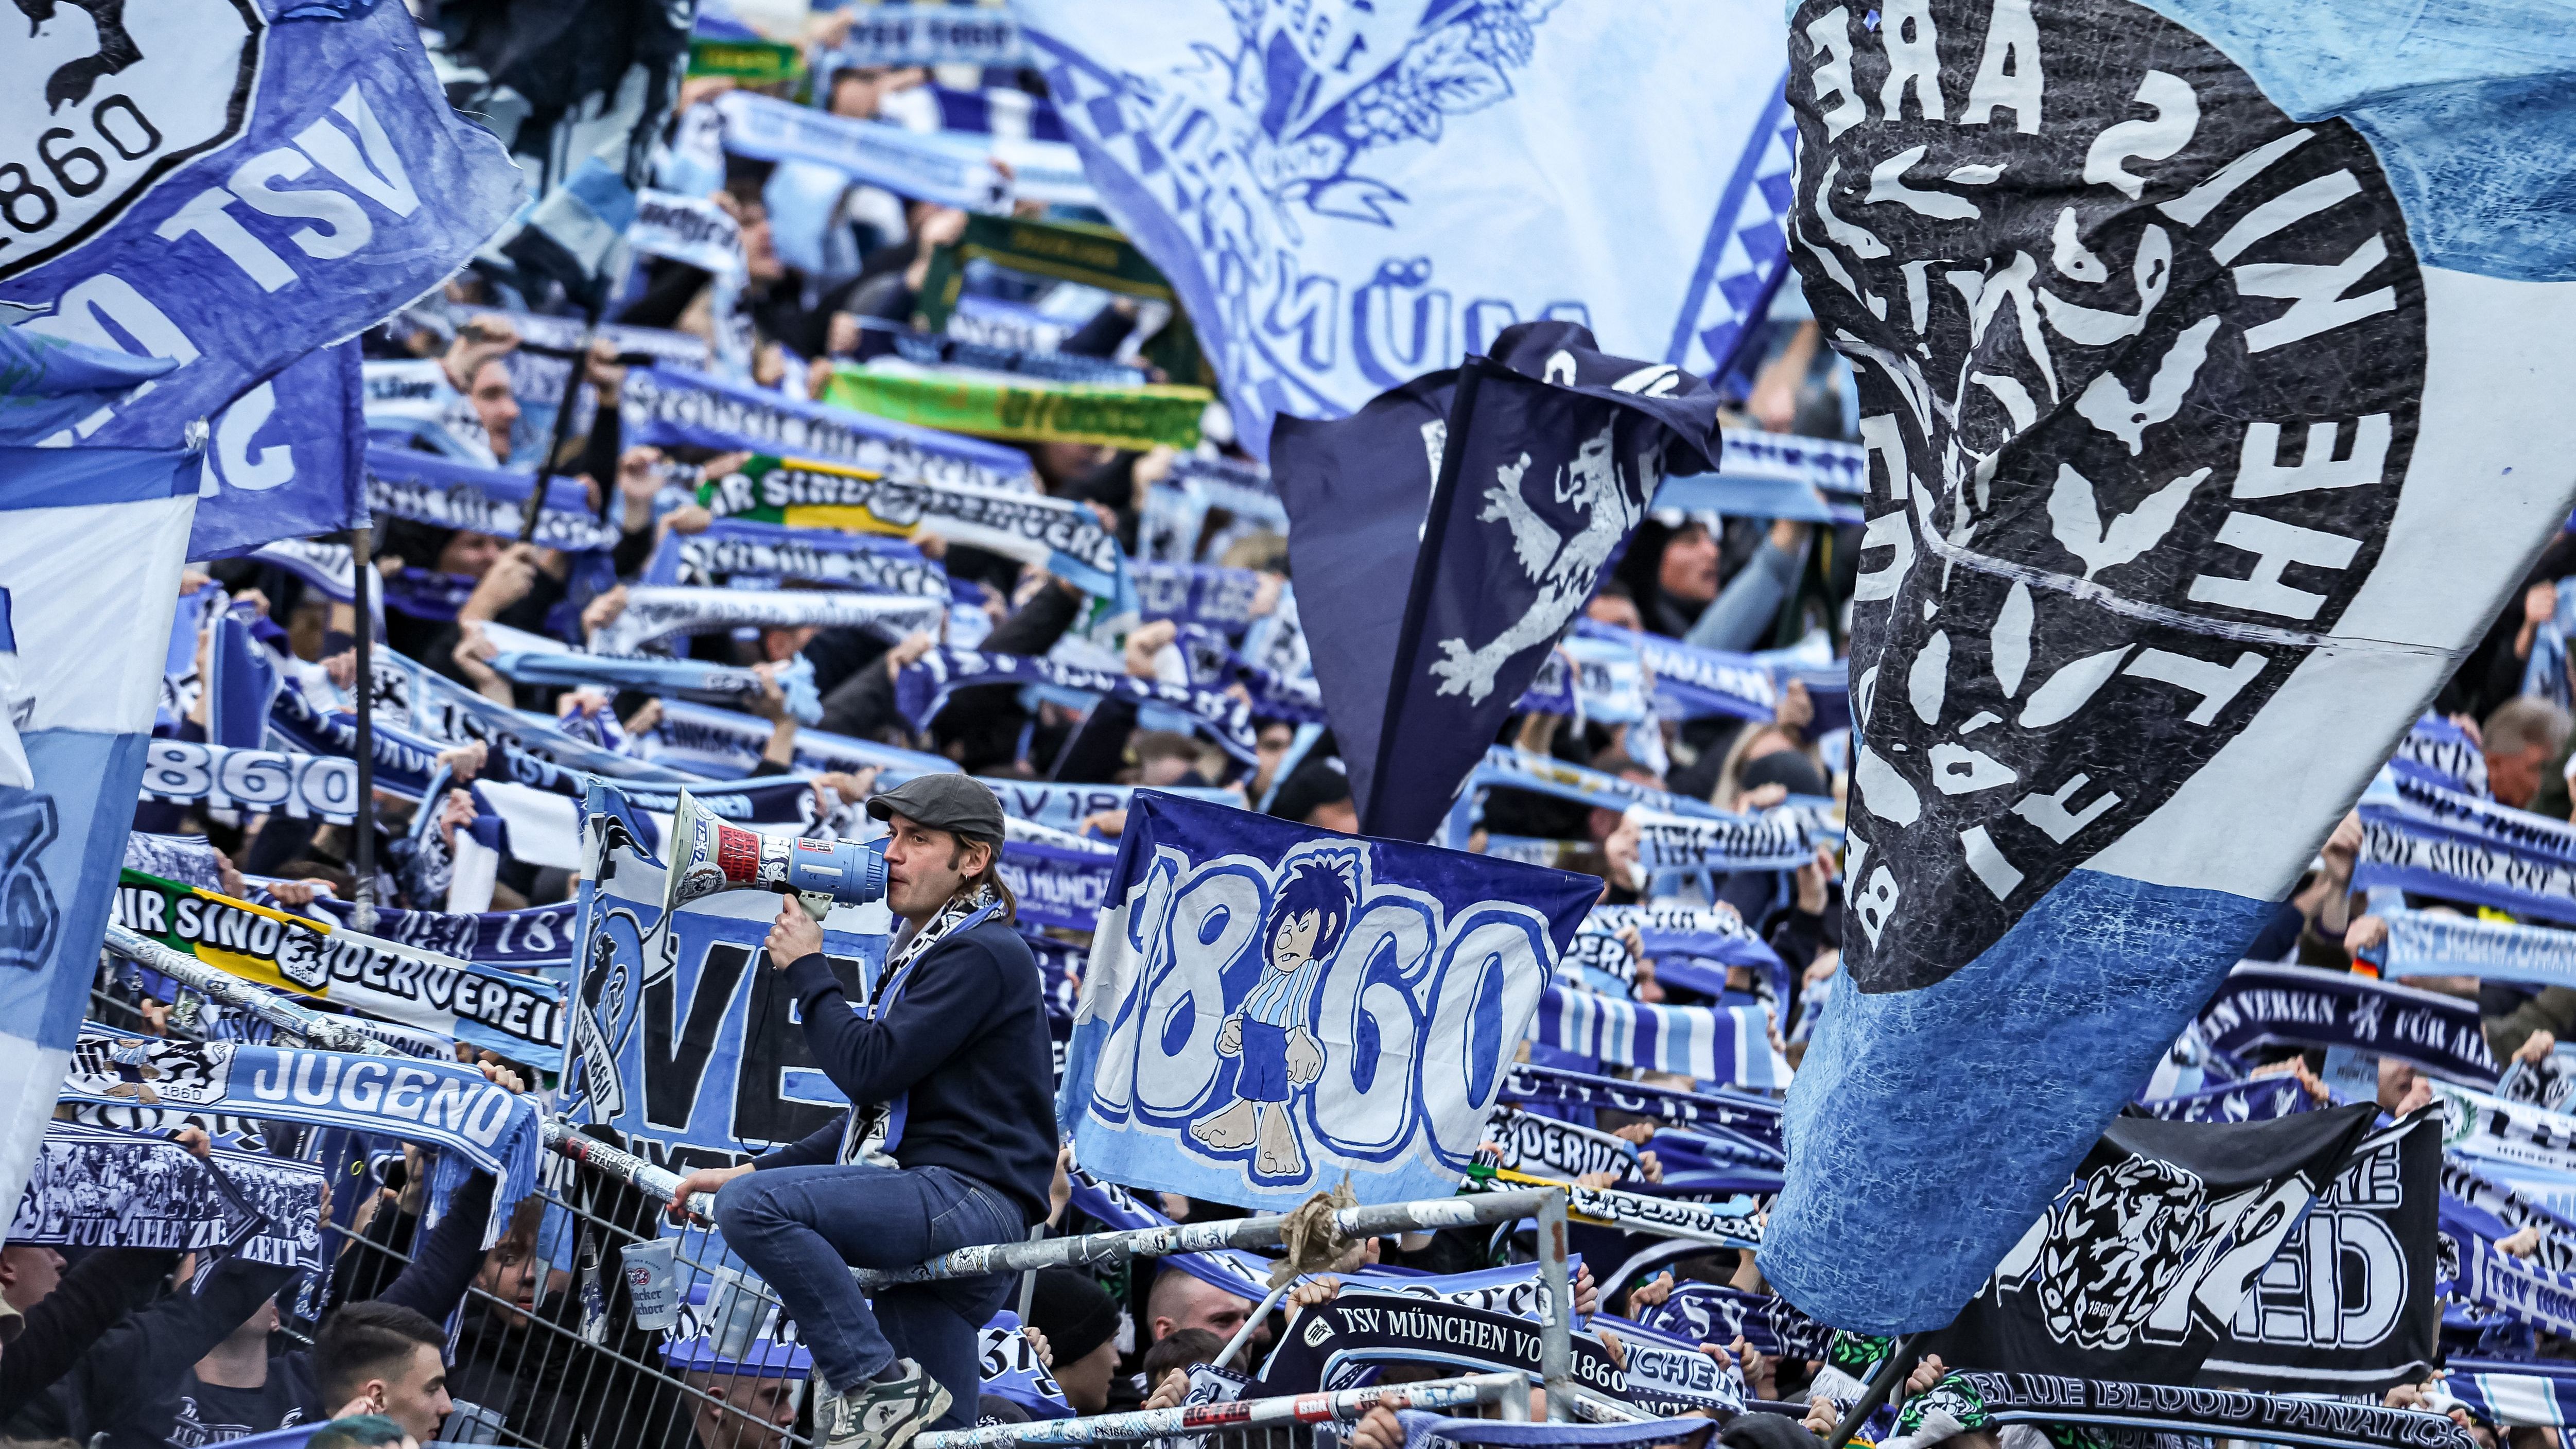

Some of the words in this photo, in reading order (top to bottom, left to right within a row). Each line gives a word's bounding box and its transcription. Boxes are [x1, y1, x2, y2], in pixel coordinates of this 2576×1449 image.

[0, 94, 163, 250] 860
[154, 82, 423, 293] TSV
[176, 897, 281, 955] SIND
[334, 940, 415, 996] DER
[1087, 847, 1548, 1174] 1860
[2236, 989, 2337, 1025] VEREIN
[2395, 1001, 2446, 1048] FÜR
[162, 1086, 202, 1101] 1860
[253, 1050, 514, 1148] JUGEND
[589, 1043, 613, 1107] 1860
[121, 1218, 184, 1248] ALLE
[632, 1287, 662, 1301] acker
[2087, 1300, 2113, 1319] 1860
[2489, 1262, 2532, 1308] TSV
[1337, 1307, 1380, 1334] TSV
[1386, 1306, 1509, 1352] MÜNCHEN
[1514, 1329, 1542, 1363] VO
[1569, 1350, 1628, 1393] 1860
[1971, 1371, 2084, 1407] BLUE
[2095, 1379, 2257, 1420] BLOOD
[2264, 1397, 2475, 1448] FANATICS
